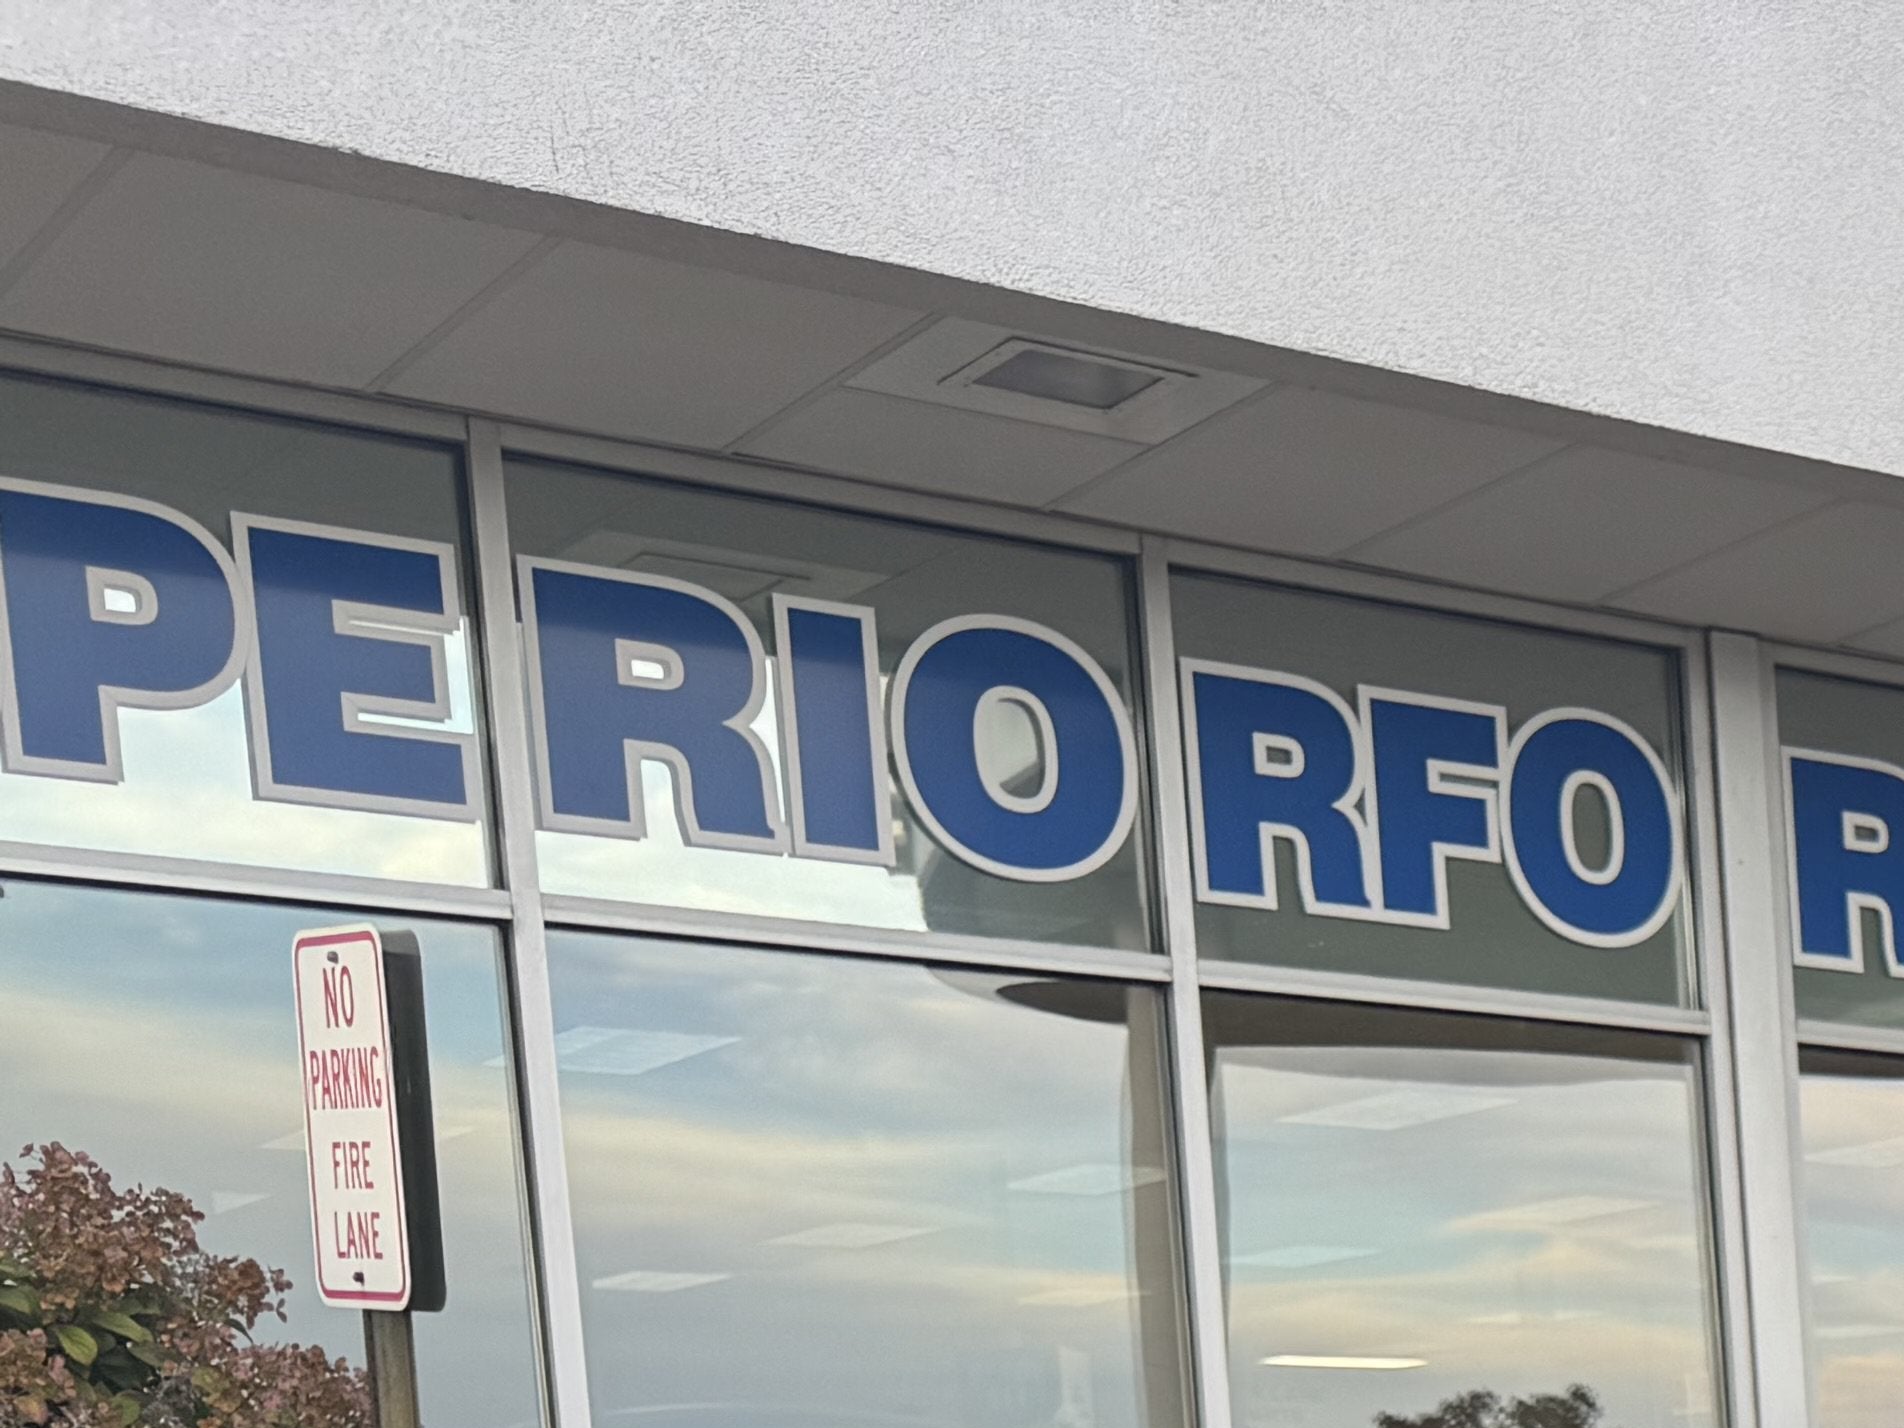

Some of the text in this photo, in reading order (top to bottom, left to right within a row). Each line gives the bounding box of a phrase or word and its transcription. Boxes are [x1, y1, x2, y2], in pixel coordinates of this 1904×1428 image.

[322, 964, 355, 1028] NO
[309, 1046, 382, 1110] PARKING
[332, 1141, 374, 1190] FIRE
[334, 1211, 383, 1260] LANE
